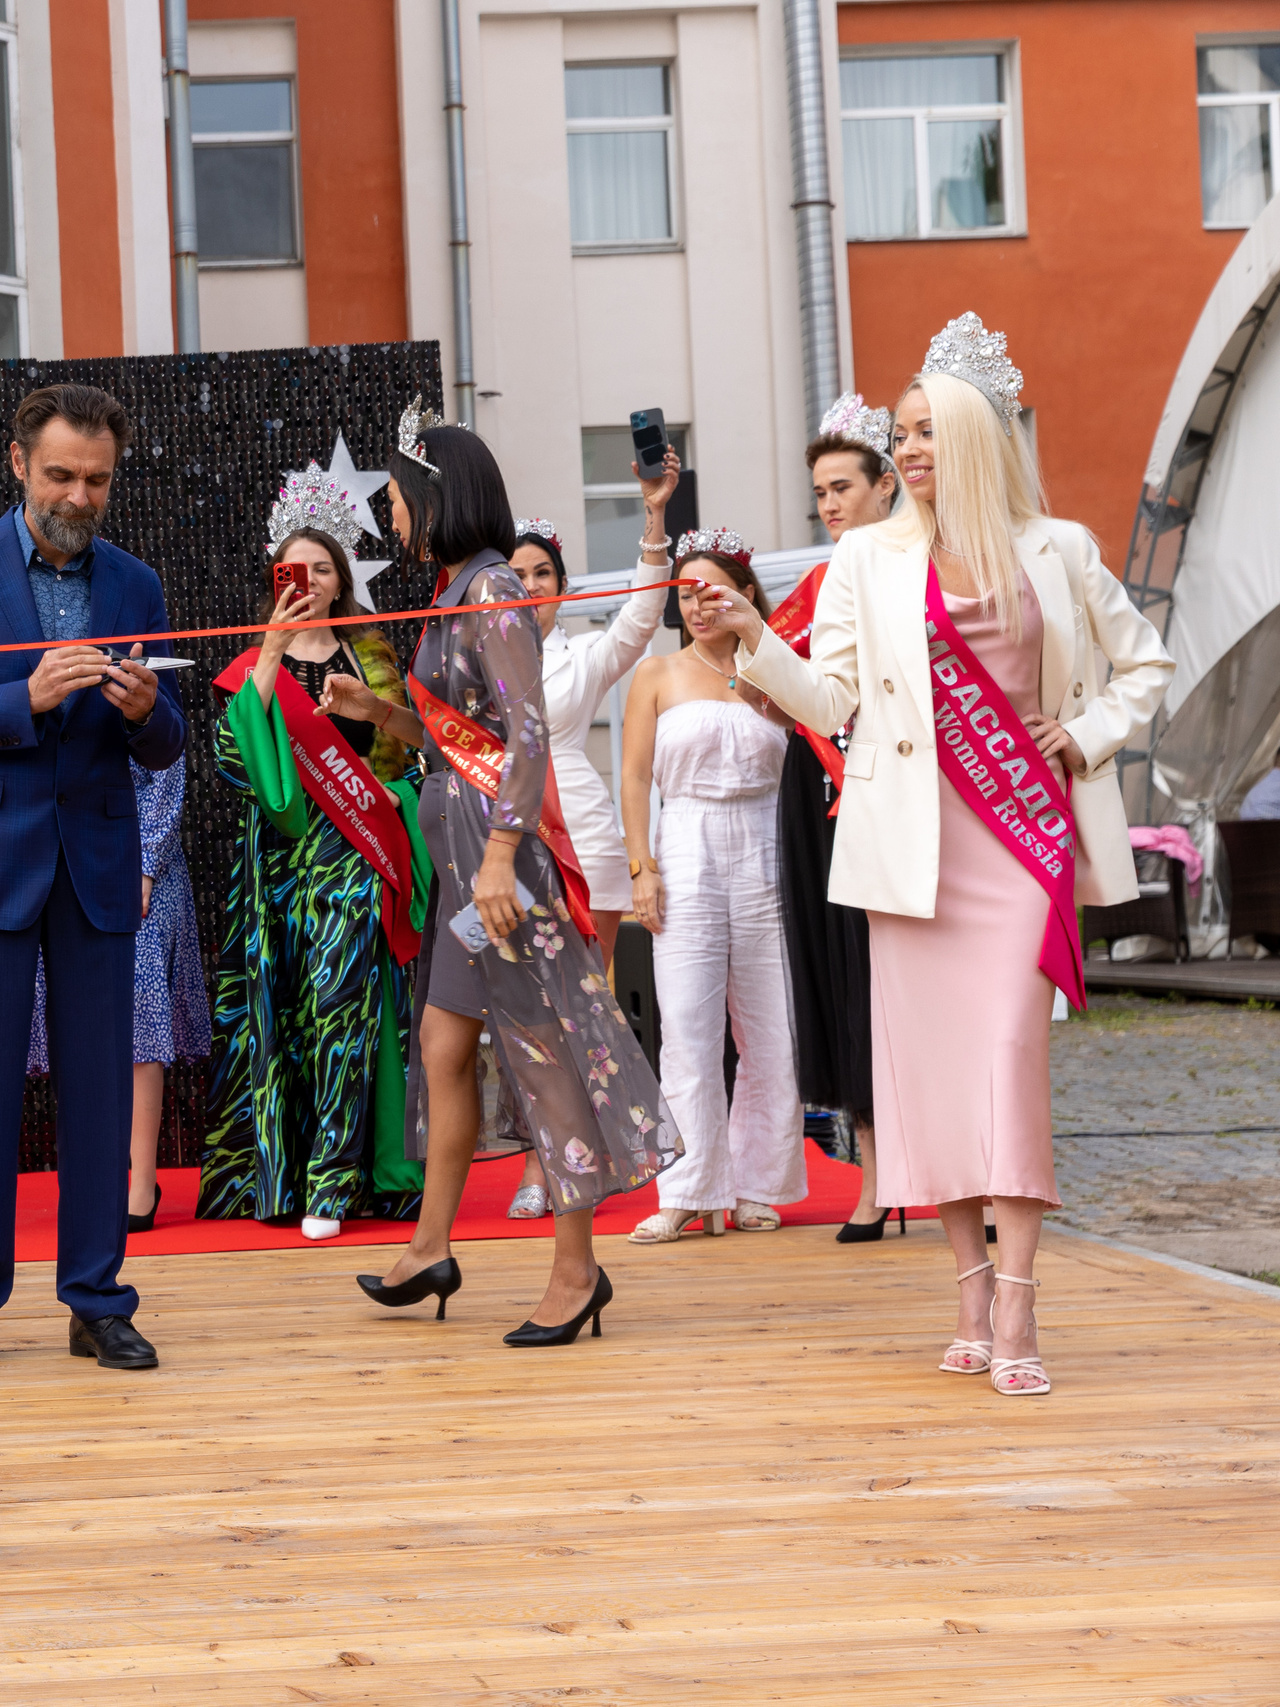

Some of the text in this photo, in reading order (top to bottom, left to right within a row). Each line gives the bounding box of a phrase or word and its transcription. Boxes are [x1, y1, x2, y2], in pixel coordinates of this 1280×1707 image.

[424, 701, 476, 749] VICE
[441, 745, 470, 770] Saint
[925, 605, 1075, 858] МБАССАДОР
[292, 742, 325, 783] Woman
[322, 780, 349, 811] Saint
[345, 807, 388, 865] Petersburg
[320, 745, 376, 812] MISS
[934, 701, 1064, 878] Woman Russia
